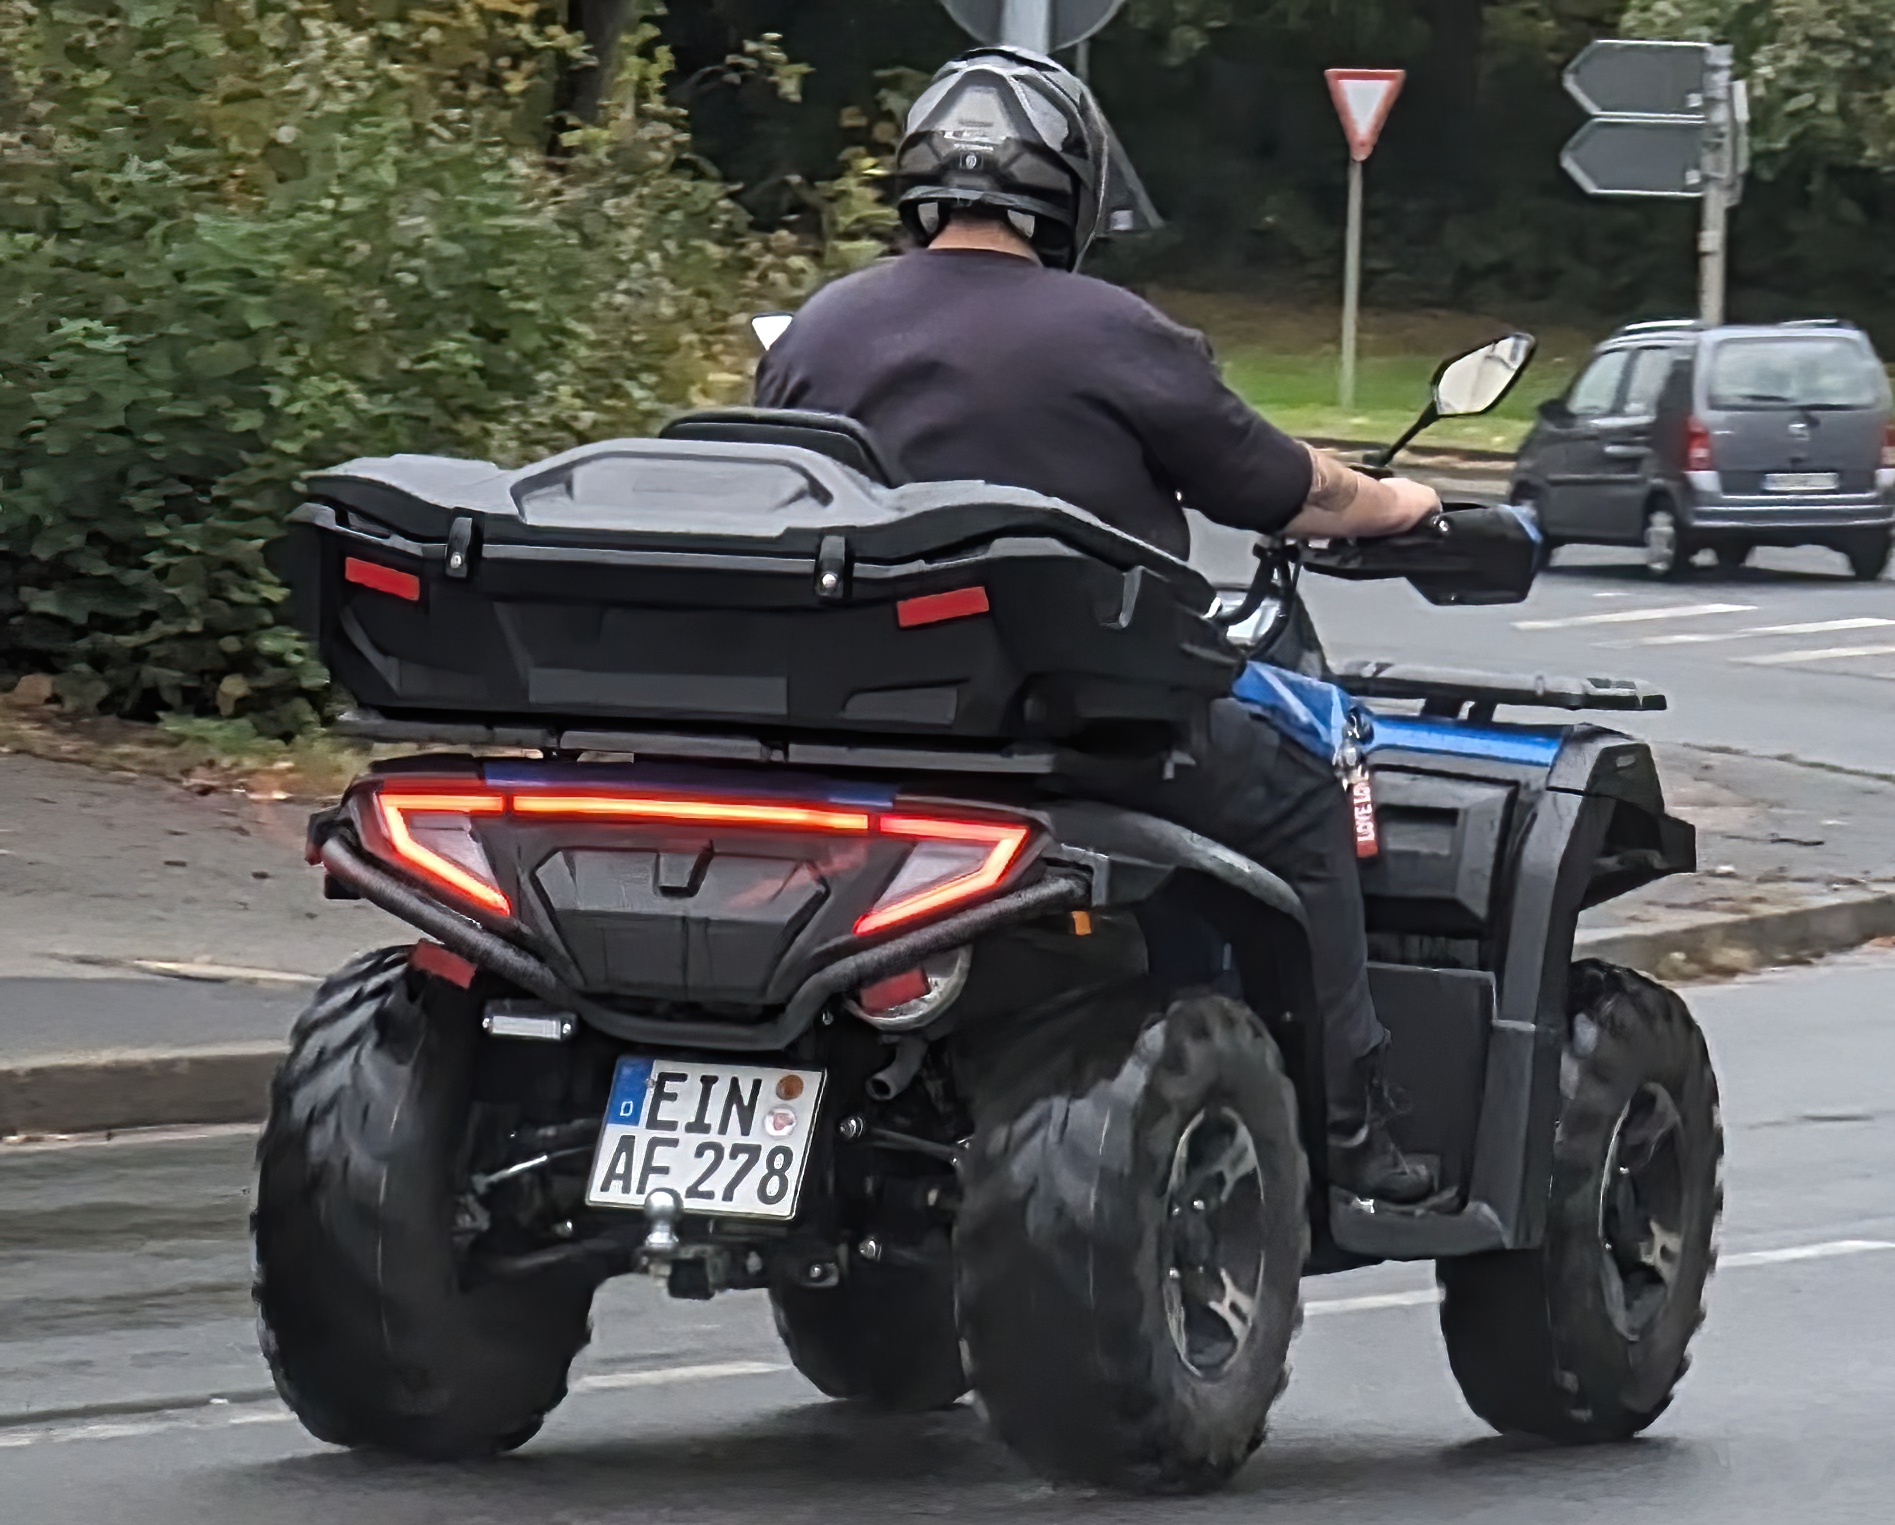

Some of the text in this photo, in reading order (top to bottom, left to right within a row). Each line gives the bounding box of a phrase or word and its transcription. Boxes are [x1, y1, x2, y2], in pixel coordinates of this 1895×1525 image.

[620, 1101, 634, 1117] D
[645, 1071, 763, 1136] EIN
[600, 1134, 794, 1205] AF 278
